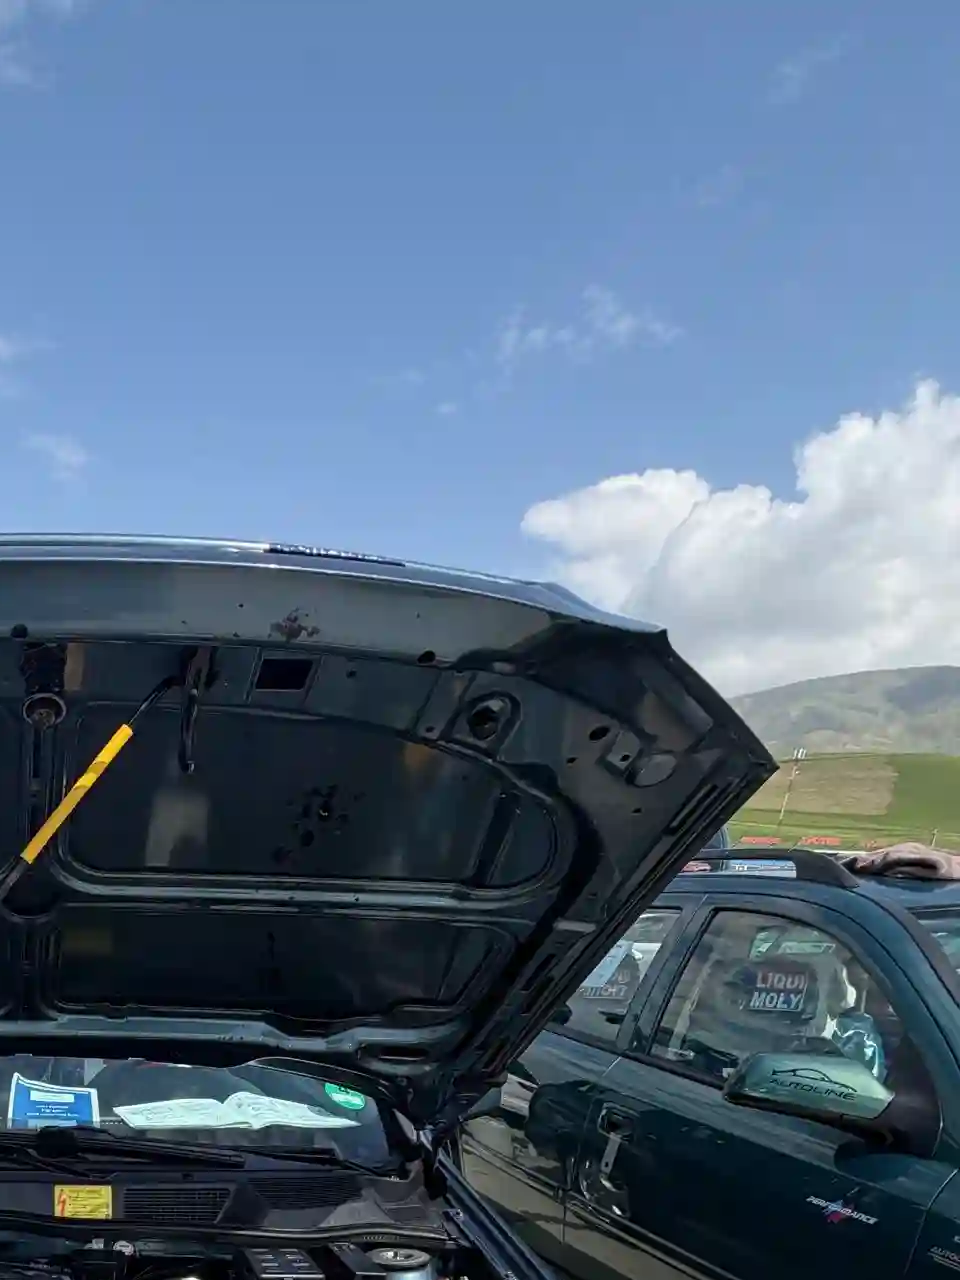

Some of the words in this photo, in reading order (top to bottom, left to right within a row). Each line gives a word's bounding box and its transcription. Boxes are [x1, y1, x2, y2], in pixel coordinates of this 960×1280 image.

[756, 972, 807, 989] LIQUI
[749, 991, 802, 1009] MOLY
[770, 1079, 857, 1101] AUTOLINE
